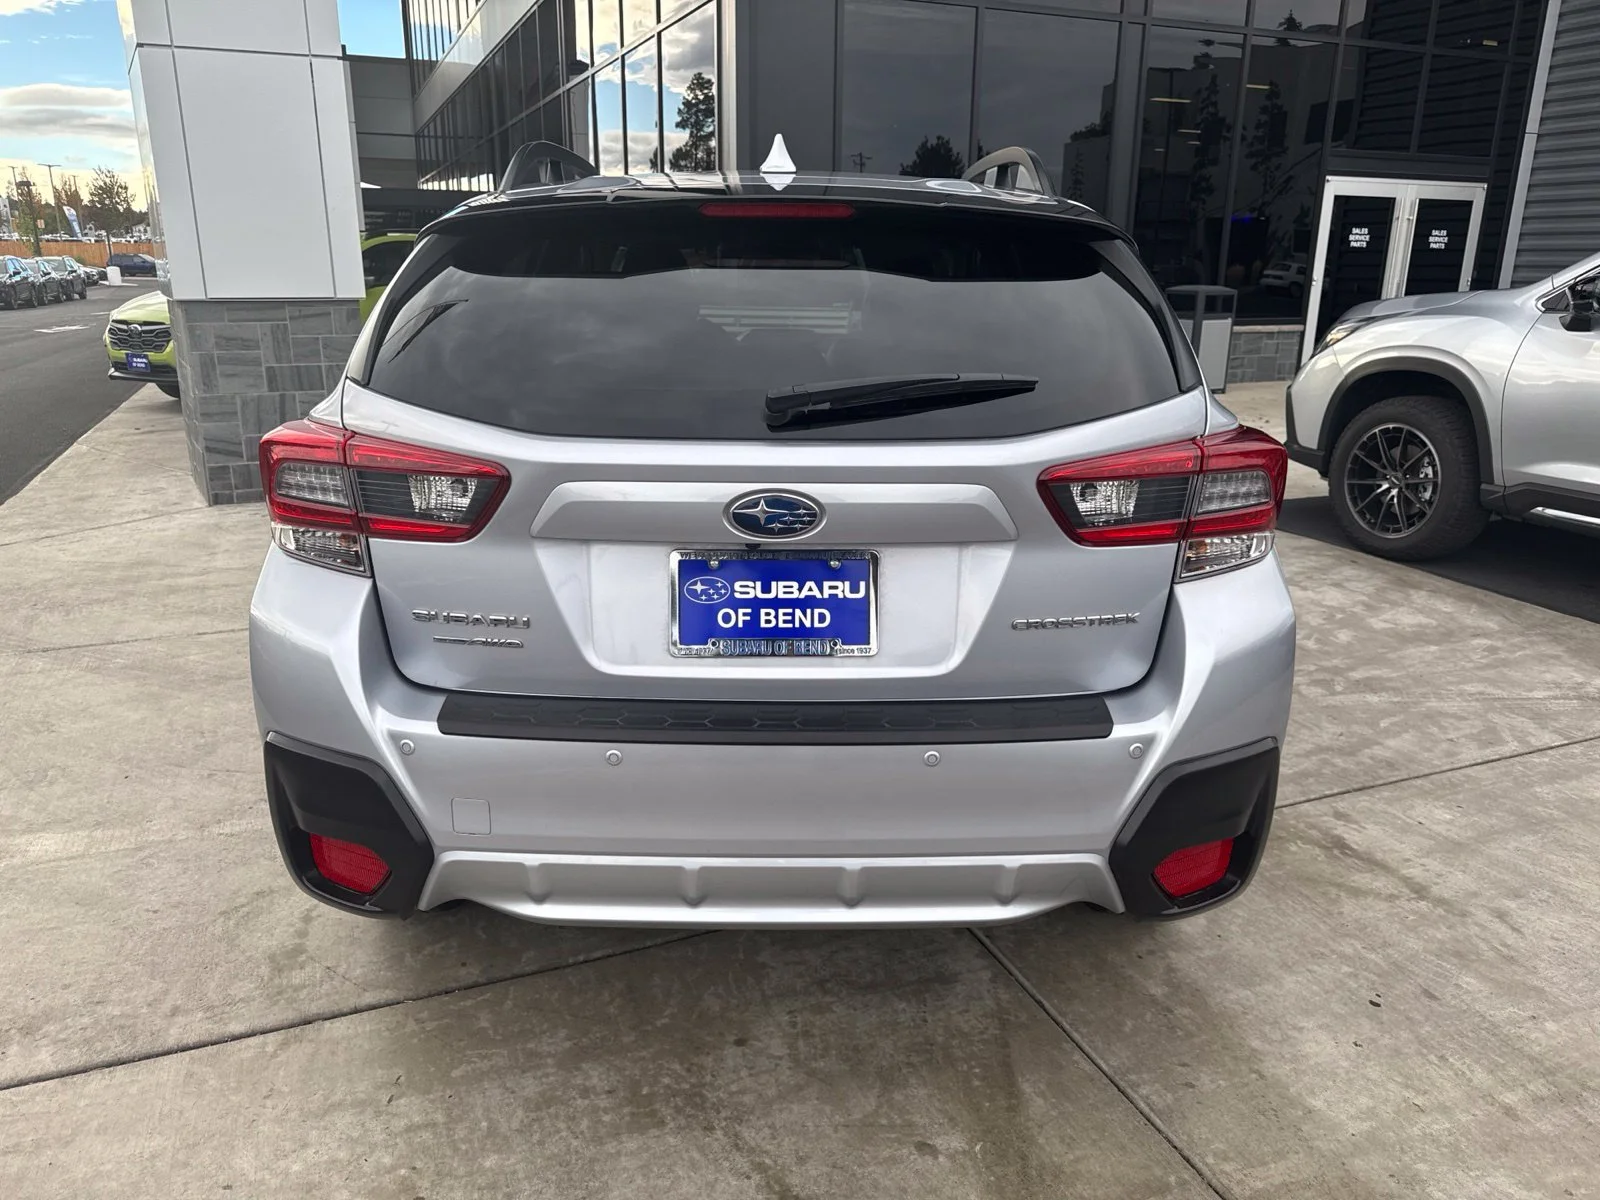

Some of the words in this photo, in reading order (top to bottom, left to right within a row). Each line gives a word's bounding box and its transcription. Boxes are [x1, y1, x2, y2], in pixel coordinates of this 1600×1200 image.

[733, 580, 866, 599] SUBARU
[411, 609, 531, 629] SUBARU
[717, 608, 752, 628] OF
[760, 608, 831, 628] BEND
[1011, 612, 1140, 631] CROSSTREK
[720, 639, 772, 656] SUBARU
[773, 639, 791, 656] OF
[794, 639, 831, 656] BEND
